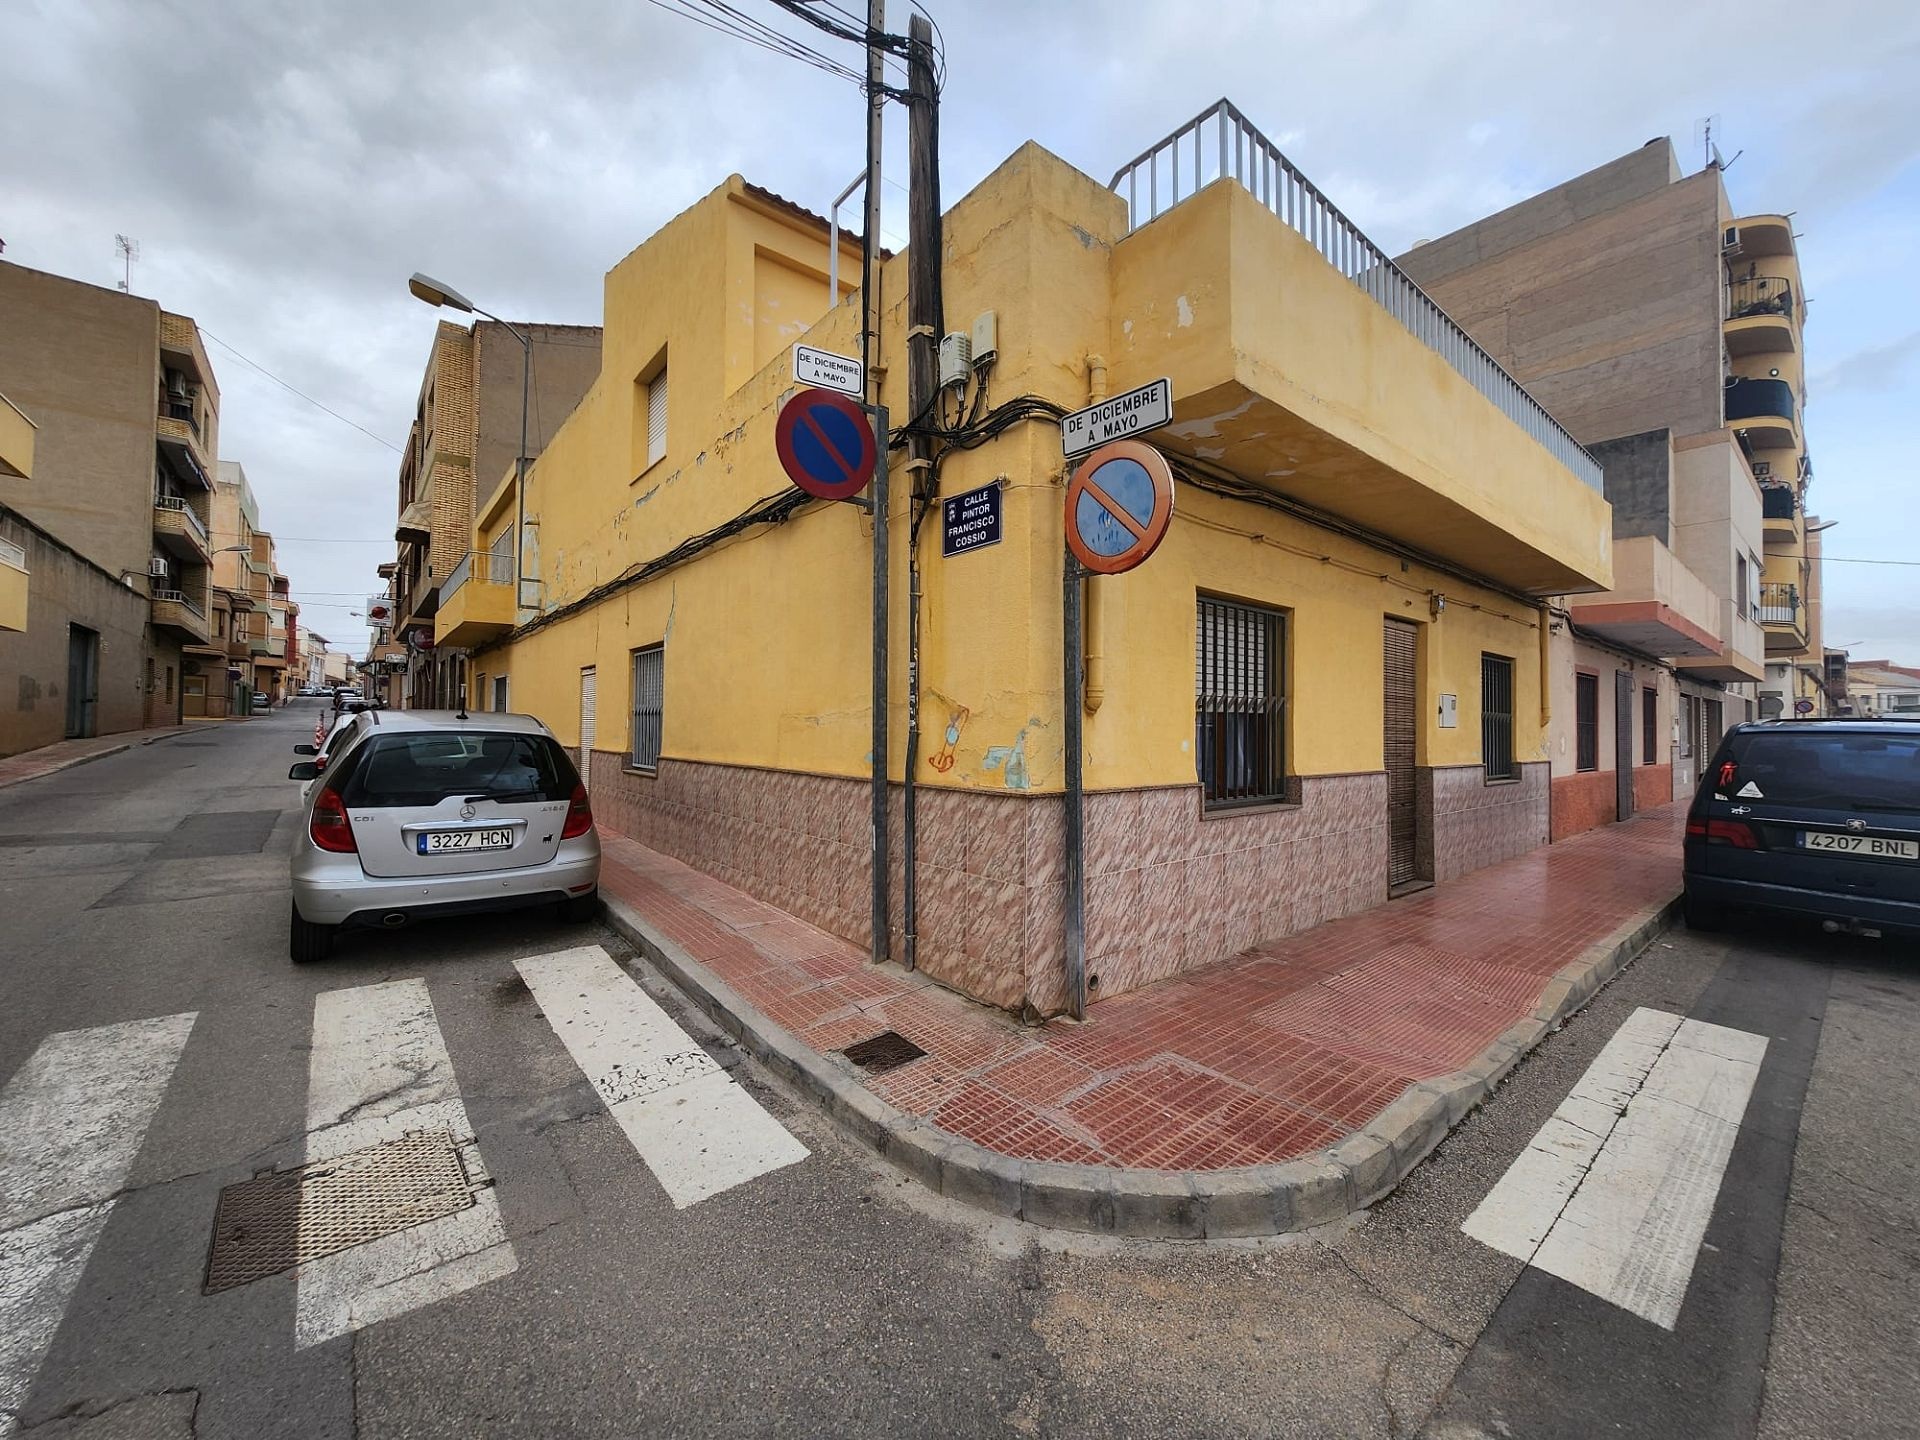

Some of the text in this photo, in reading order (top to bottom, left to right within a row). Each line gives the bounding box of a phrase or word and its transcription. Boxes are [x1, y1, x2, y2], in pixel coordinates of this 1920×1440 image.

[799, 353, 860, 376] DE DICIEMBRE
[814, 369, 847, 384] A MAYO
[1068, 387, 1159, 433] DE DICIEMBRE
[1088, 414, 1139, 443] A MAYO
[964, 490, 989, 507] CALLE
[962, 503, 990, 521] PINTOR
[948, 514, 995, 538] FRANCISCO
[955, 530, 987, 548] COSSIO
[432, 830, 510, 849] 3227 HCN
[1811, 834, 1913, 857] 4207 BNL
